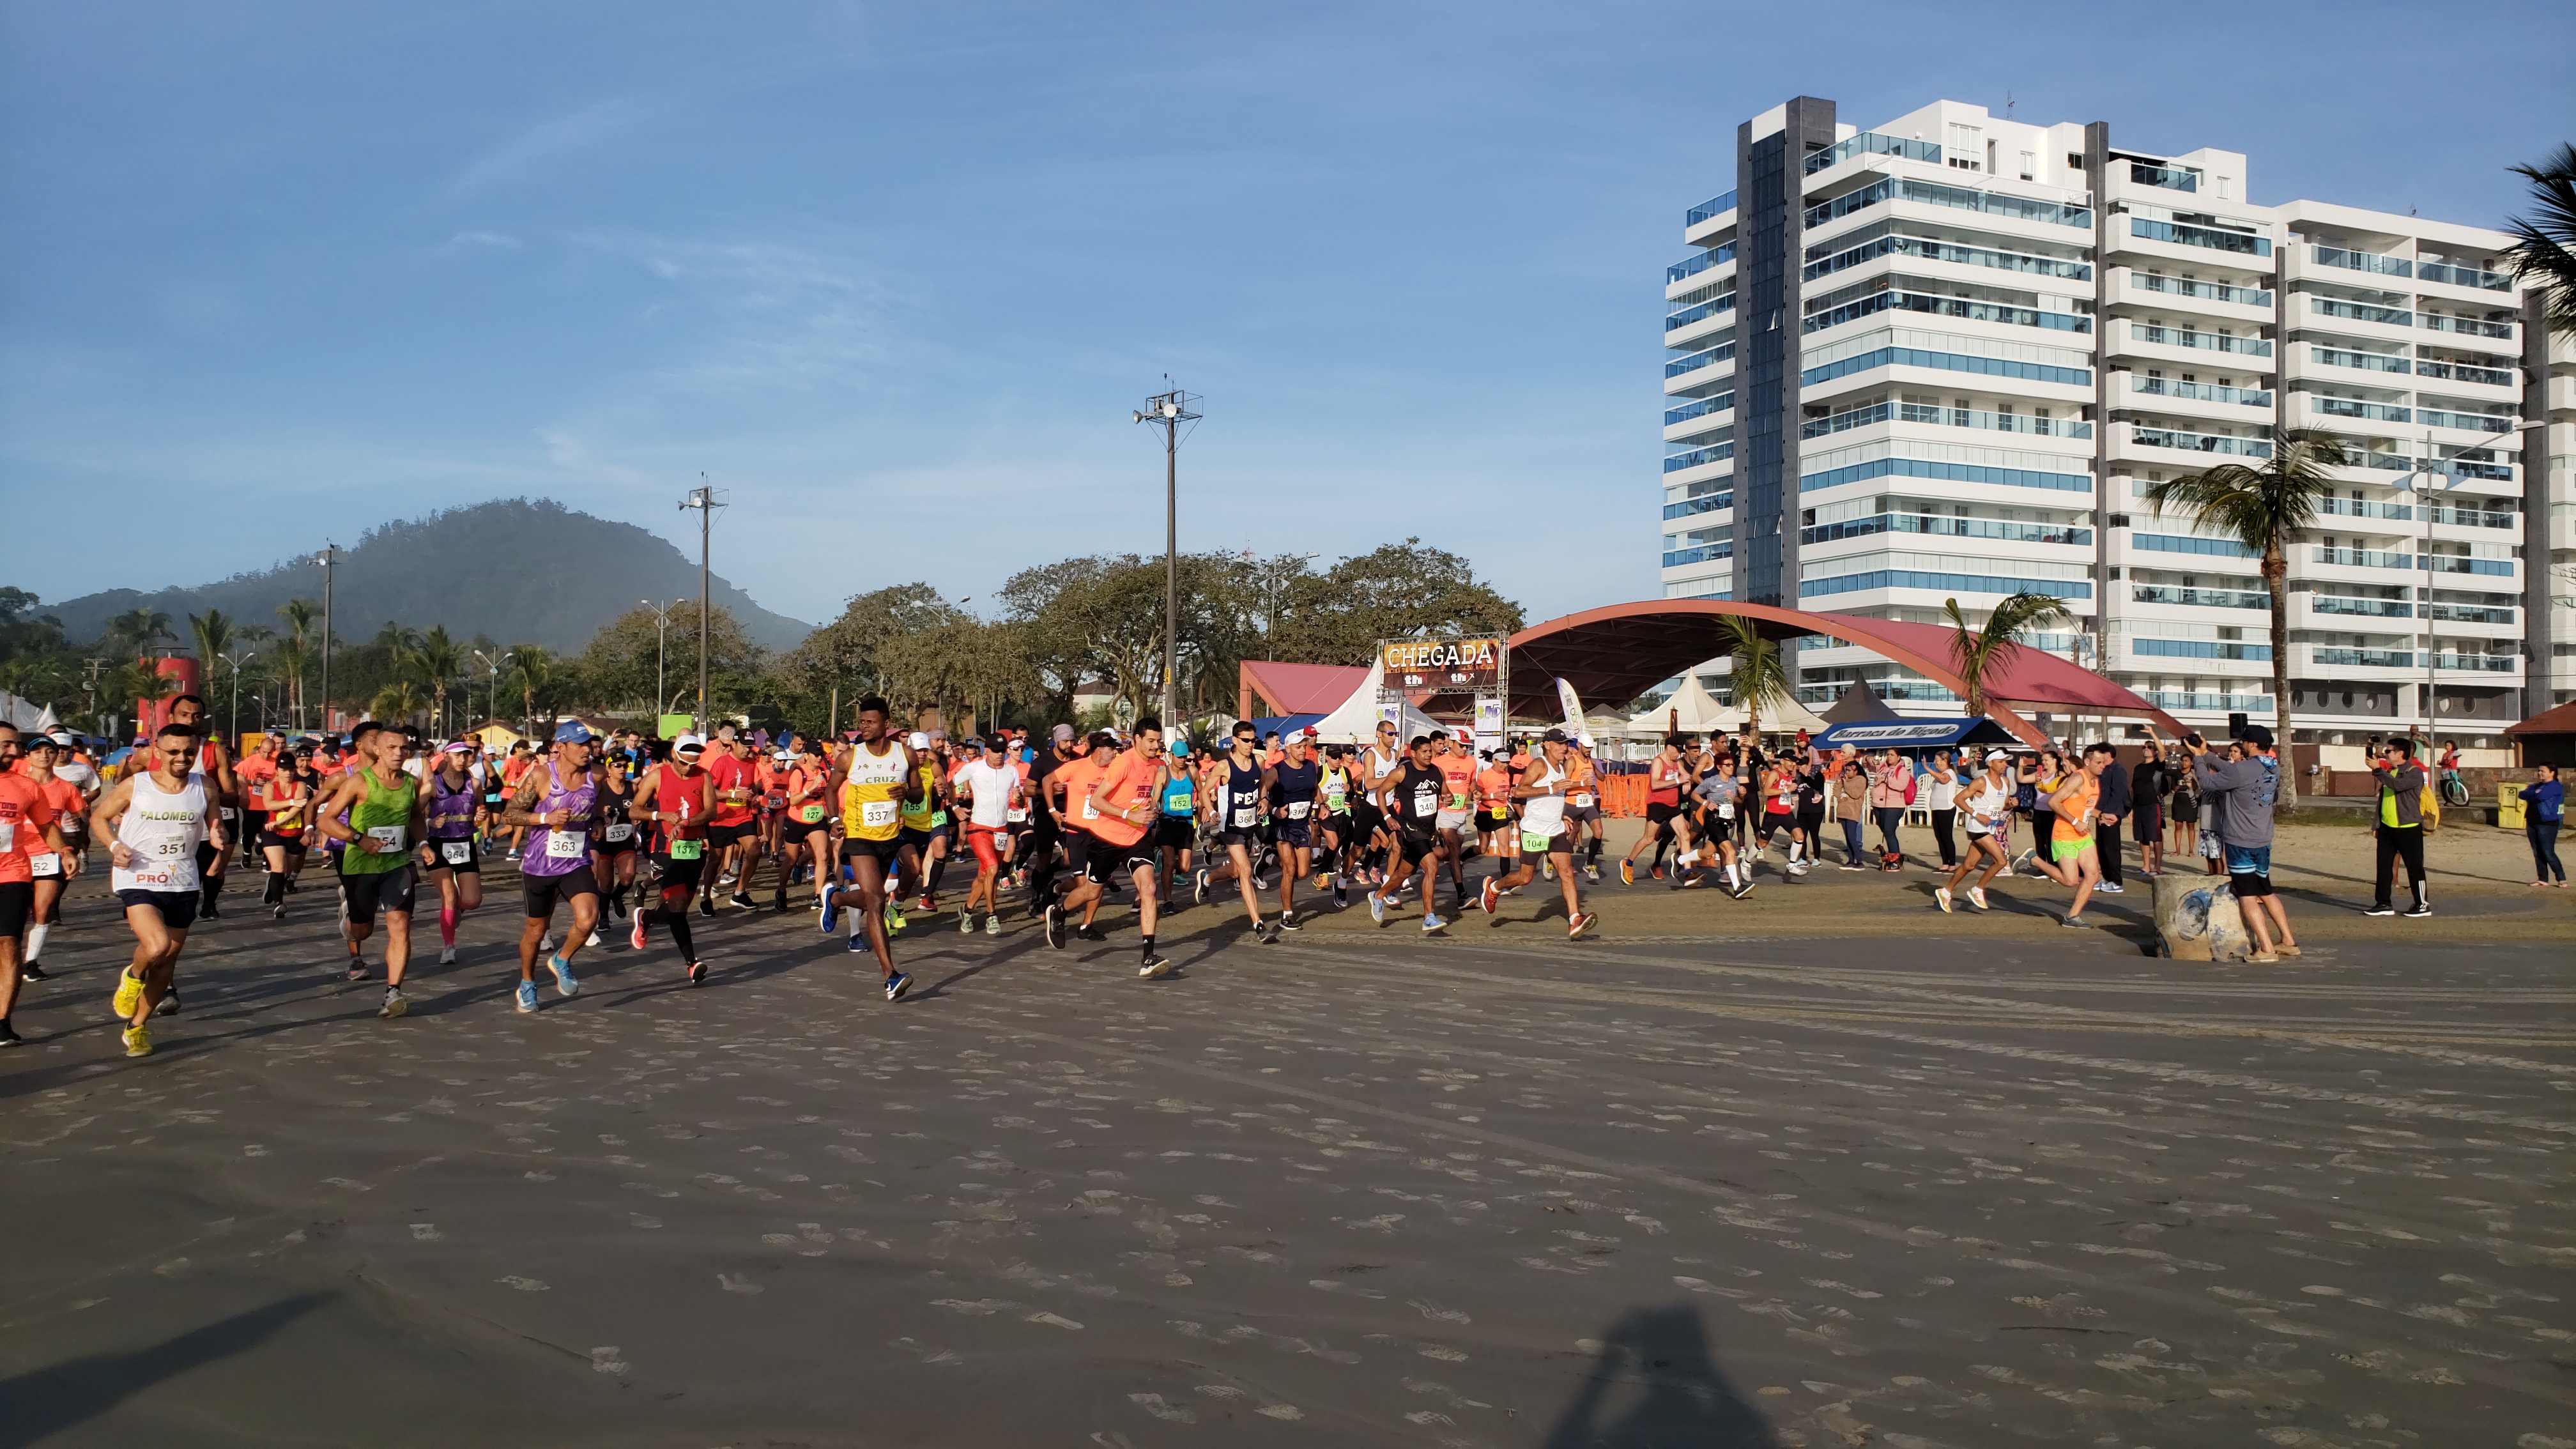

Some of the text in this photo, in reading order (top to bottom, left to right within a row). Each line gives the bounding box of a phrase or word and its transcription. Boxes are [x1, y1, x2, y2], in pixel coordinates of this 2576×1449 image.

[1388, 643, 1494, 668] CHEGADA
[1830, 725, 1956, 739] Barraca do Bigode
[865, 776, 897, 784] CRUZ
[905, 802, 921, 811] 155
[1419, 802, 1434, 813] 340
[140, 811, 195, 821] PALOMBO
[867, 810, 889, 822] 337
[1238, 815, 1252, 824] 360
[610, 831, 626, 839] 333
[158, 842, 187, 855] 351
[553, 840, 576, 852] 363
[1526, 839, 1542, 848] 104
[676, 845, 694, 854] 137
[447, 850, 465, 860] 364
